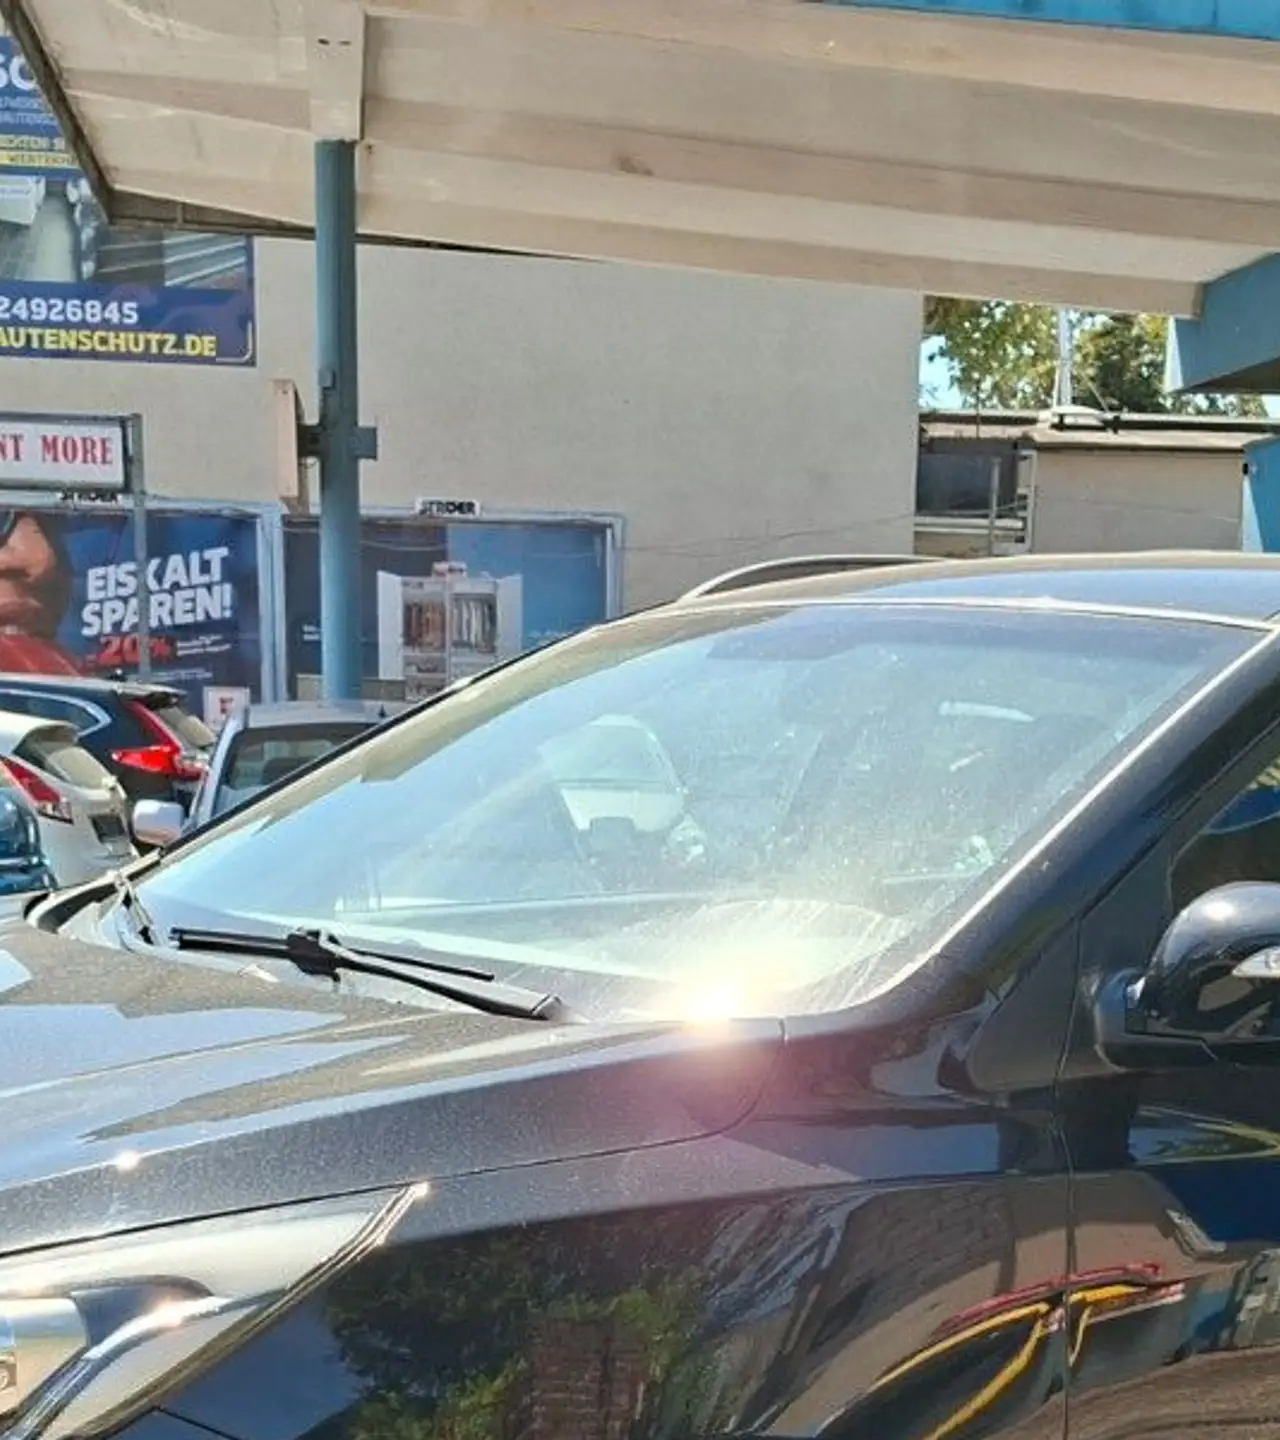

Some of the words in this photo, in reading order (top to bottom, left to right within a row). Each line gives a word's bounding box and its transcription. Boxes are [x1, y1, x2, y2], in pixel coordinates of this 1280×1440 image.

[40, 434, 114, 465] MORE
[86, 546, 229, 601] EISKALT
[81, 582, 233, 637] SPAREN!
